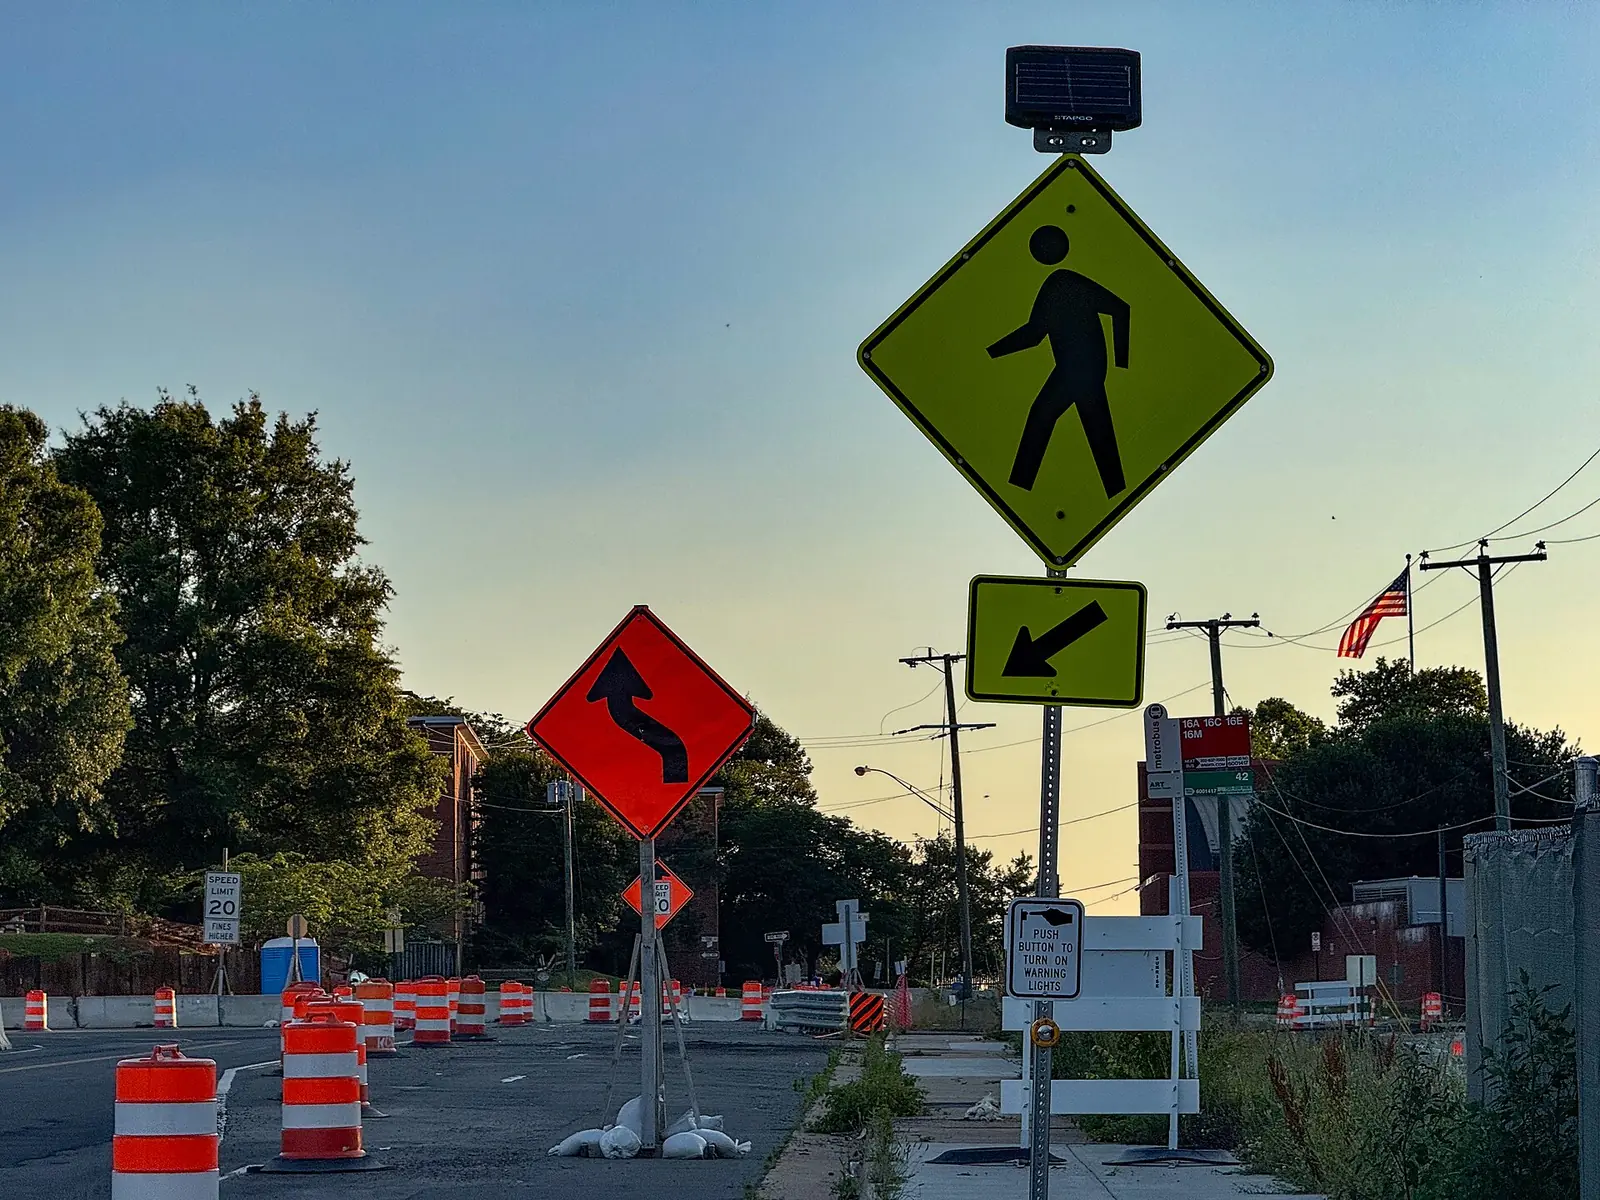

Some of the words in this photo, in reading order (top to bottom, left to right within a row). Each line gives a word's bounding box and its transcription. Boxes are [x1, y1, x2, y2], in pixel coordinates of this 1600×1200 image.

[1182, 719, 1200, 728] 16A
[1203, 718, 1222, 727] 16C
[1226, 716, 1243, 726] 16E
[1183, 730, 1203, 739] 16M
[1152, 721, 1162, 769] metrobus
[1235, 772, 1249, 781] 42
[208, 876, 239, 885] SPEED
[211, 888, 235, 896] LIMIT
[208, 900, 236, 915] 20
[211, 922, 232, 931] FINES
[208, 932, 234, 941] HIGHER
[1033, 929, 1059, 940] PUSH
[1018, 942, 1054, 952] BUTTON
[1062, 943, 1073, 953] TO
[1024, 954, 1048, 965] TURN
[1055, 955, 1068, 965] ON
[1024, 967, 1066, 978] WARNING
[1028, 980, 1061, 991] LIGHTS
